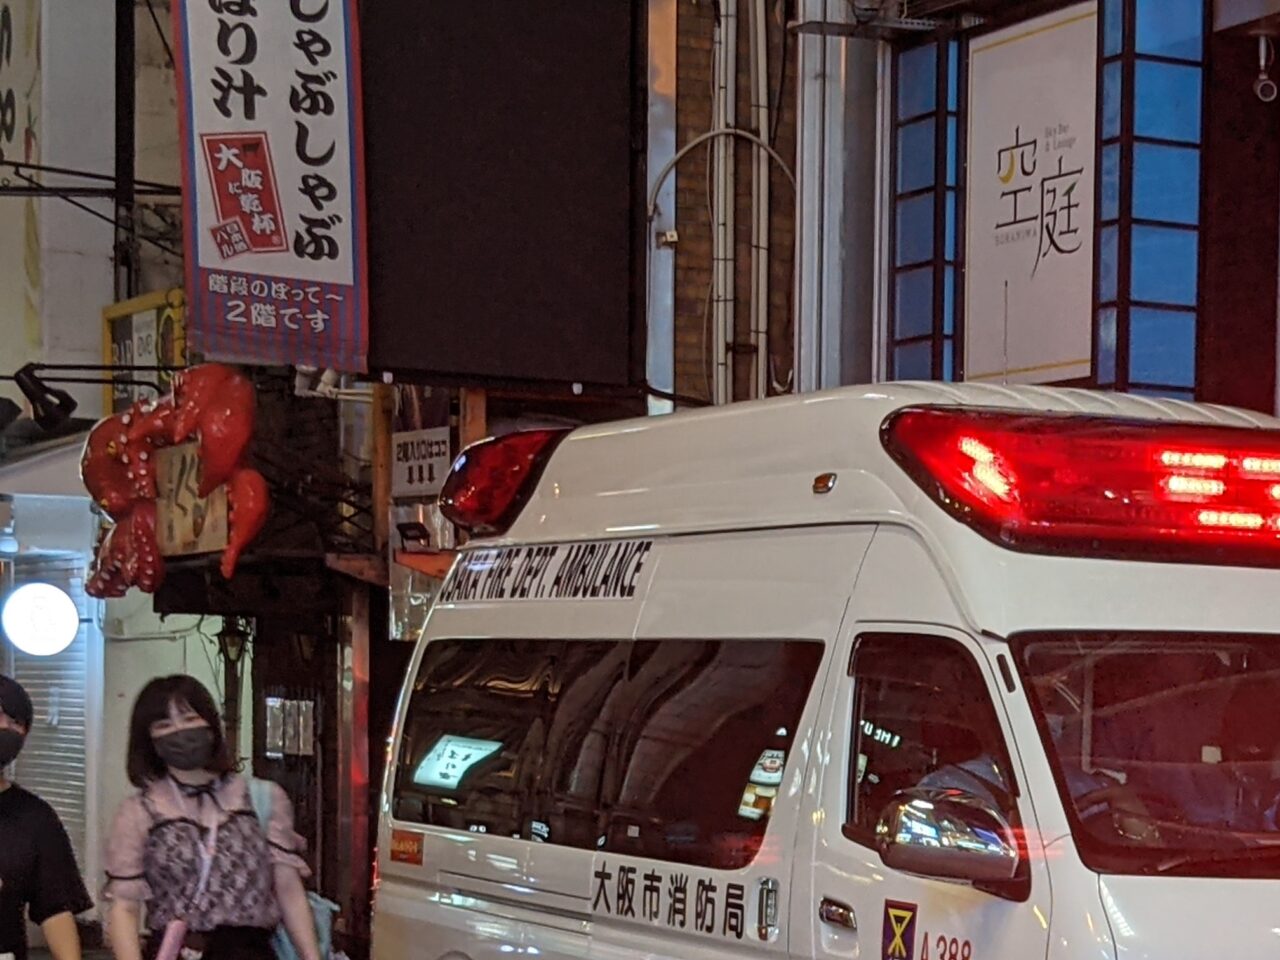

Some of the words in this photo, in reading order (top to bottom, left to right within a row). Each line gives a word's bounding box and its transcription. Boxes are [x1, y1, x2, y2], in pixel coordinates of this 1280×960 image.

[994, 125, 1085, 281] 空庭
[226, 300, 330, 333] 2階です
[480, 547, 522, 599] FIRE
[509, 545, 559, 598] DEPT.
[548, 540, 653, 598] AMBULANCE
[592, 860, 745, 940] 大阪市消防局
